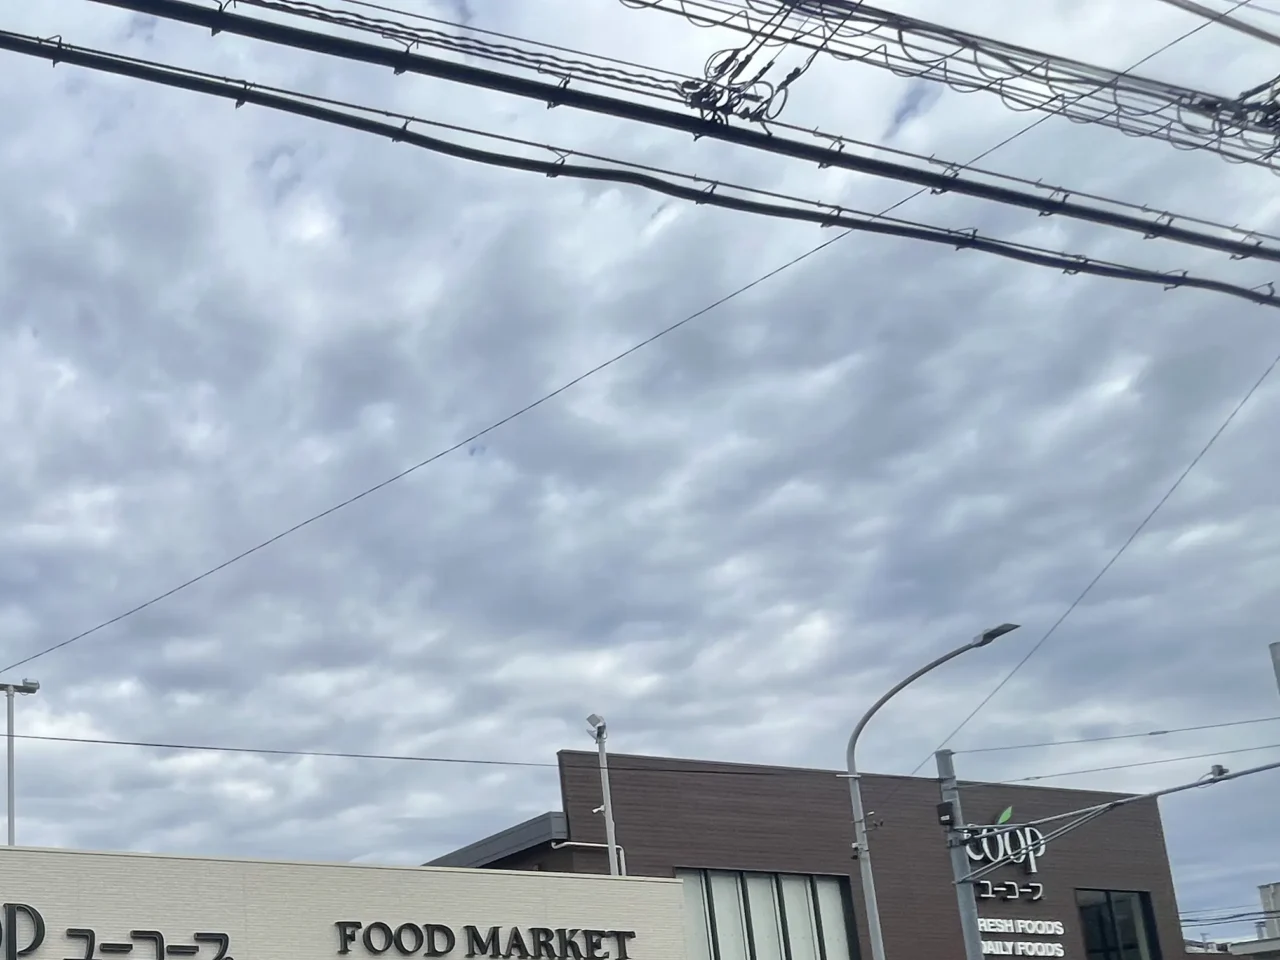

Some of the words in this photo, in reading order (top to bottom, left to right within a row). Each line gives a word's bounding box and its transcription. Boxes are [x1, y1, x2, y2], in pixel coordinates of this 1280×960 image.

[977, 918, 1014, 933] RESH
[1015, 919, 1065, 935] FOODS
[335, 920, 456, 957] FOOD
[1015, 941, 1065, 957] FOODS
